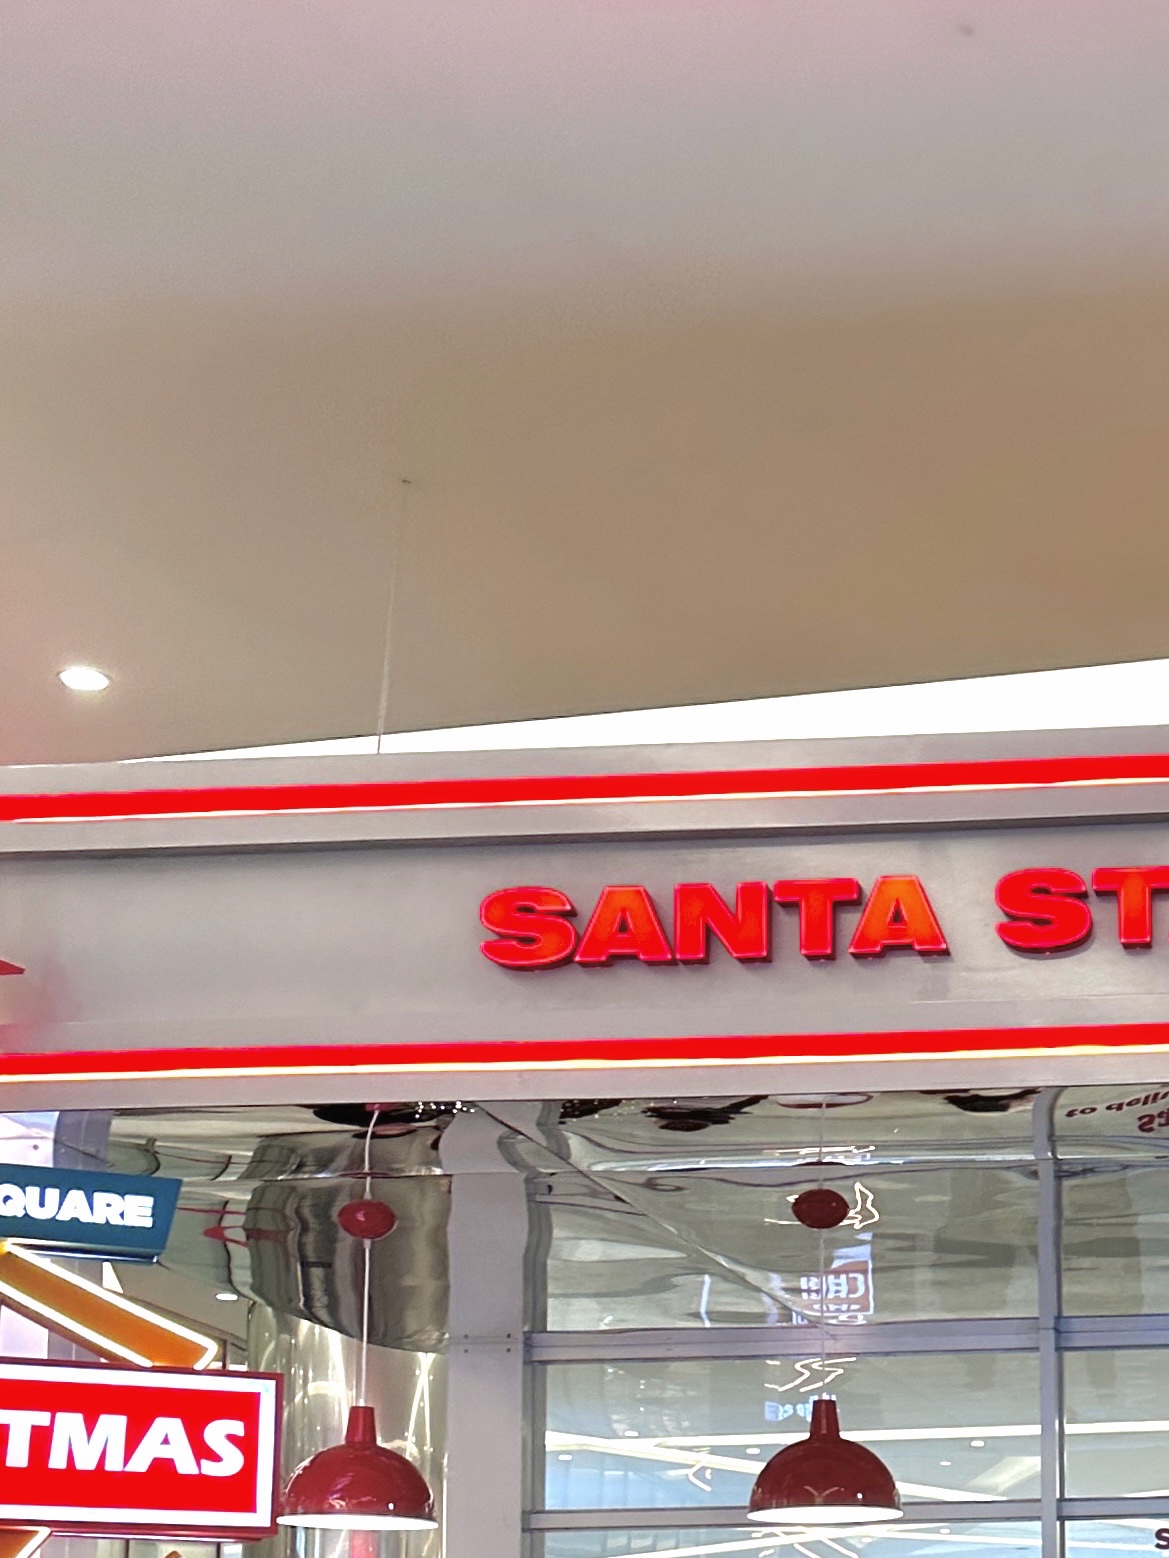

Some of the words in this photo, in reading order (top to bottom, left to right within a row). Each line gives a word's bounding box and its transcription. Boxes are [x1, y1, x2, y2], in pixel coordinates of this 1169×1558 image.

[479, 874, 948, 970] SANTA
[0, 1183, 154, 1227] QUARE
[0, 1408, 245, 1477] TMAS
